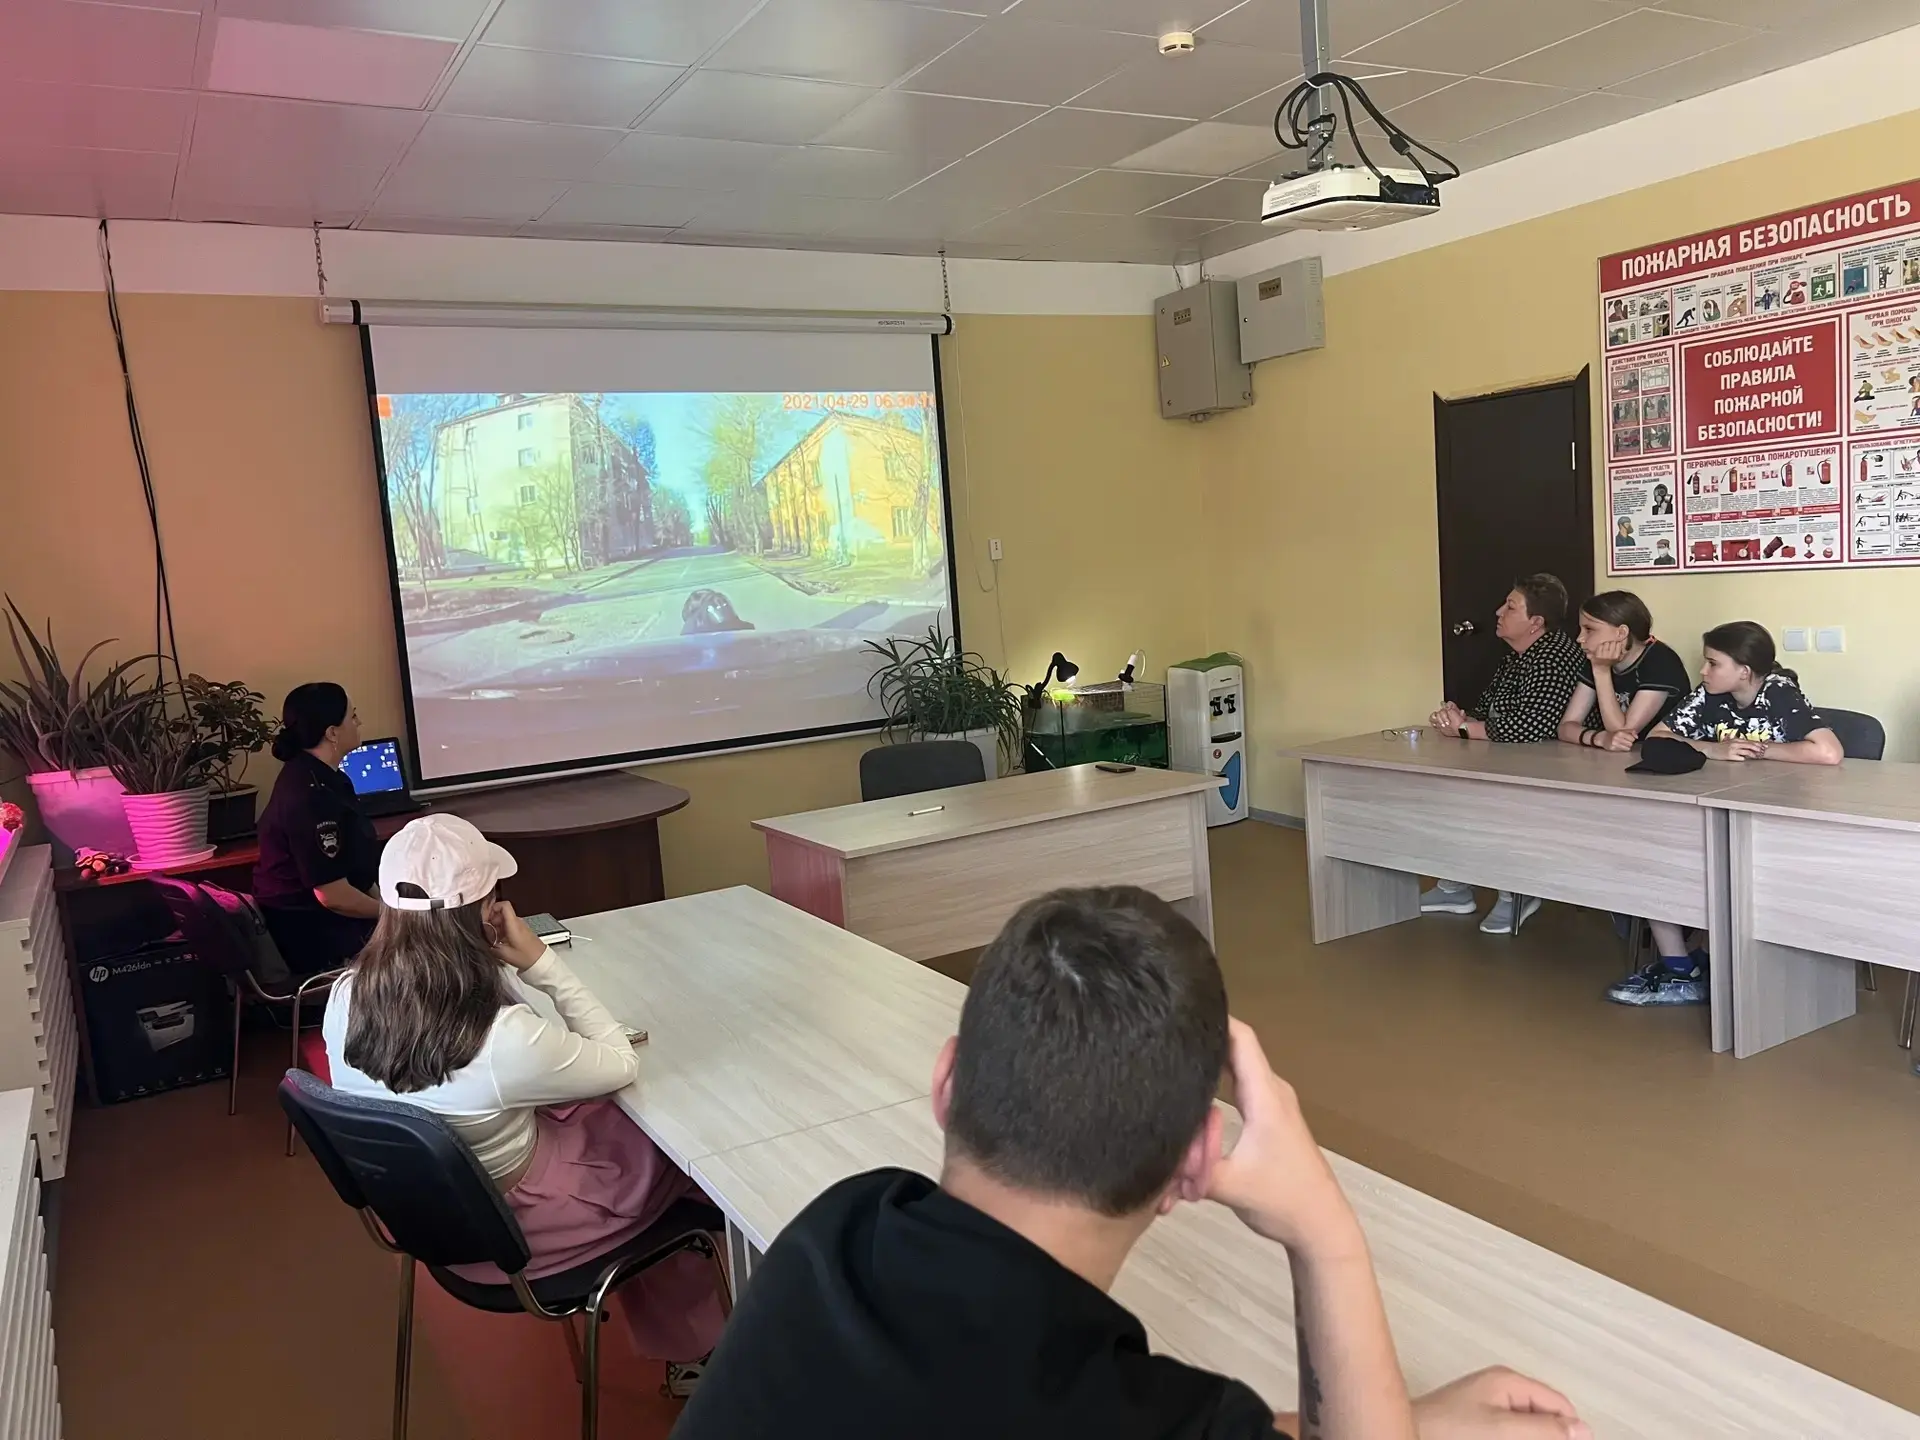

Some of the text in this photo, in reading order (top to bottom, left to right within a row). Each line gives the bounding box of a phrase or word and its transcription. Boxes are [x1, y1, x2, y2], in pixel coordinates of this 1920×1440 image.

[1621, 234, 1731, 281] ПОЖАРНАЯ
[1739, 193, 1911, 252] БЕЗОПАСНОСТЬ
[1865, 306, 1918, 320] ПЕРВАЯ ПОМОЩЬ
[1885, 315, 1911, 324] ОЖОГАХ
[1704, 335, 1814, 369] СОБЛЮДАЙТЕ
[1720, 364, 1796, 391] ПРАВИЛА
[1714, 384, 1804, 416] ПОЖАРНОЙ
[1698, 410, 1822, 441] БЕЗОПАСНОСТИ!
[1686, 446, 1837, 470] ПЕРВИЧНЫЕ СРЕДСТВА ПОЖАРОТУШЕНИЯ
[89, 966, 109, 982] hp
